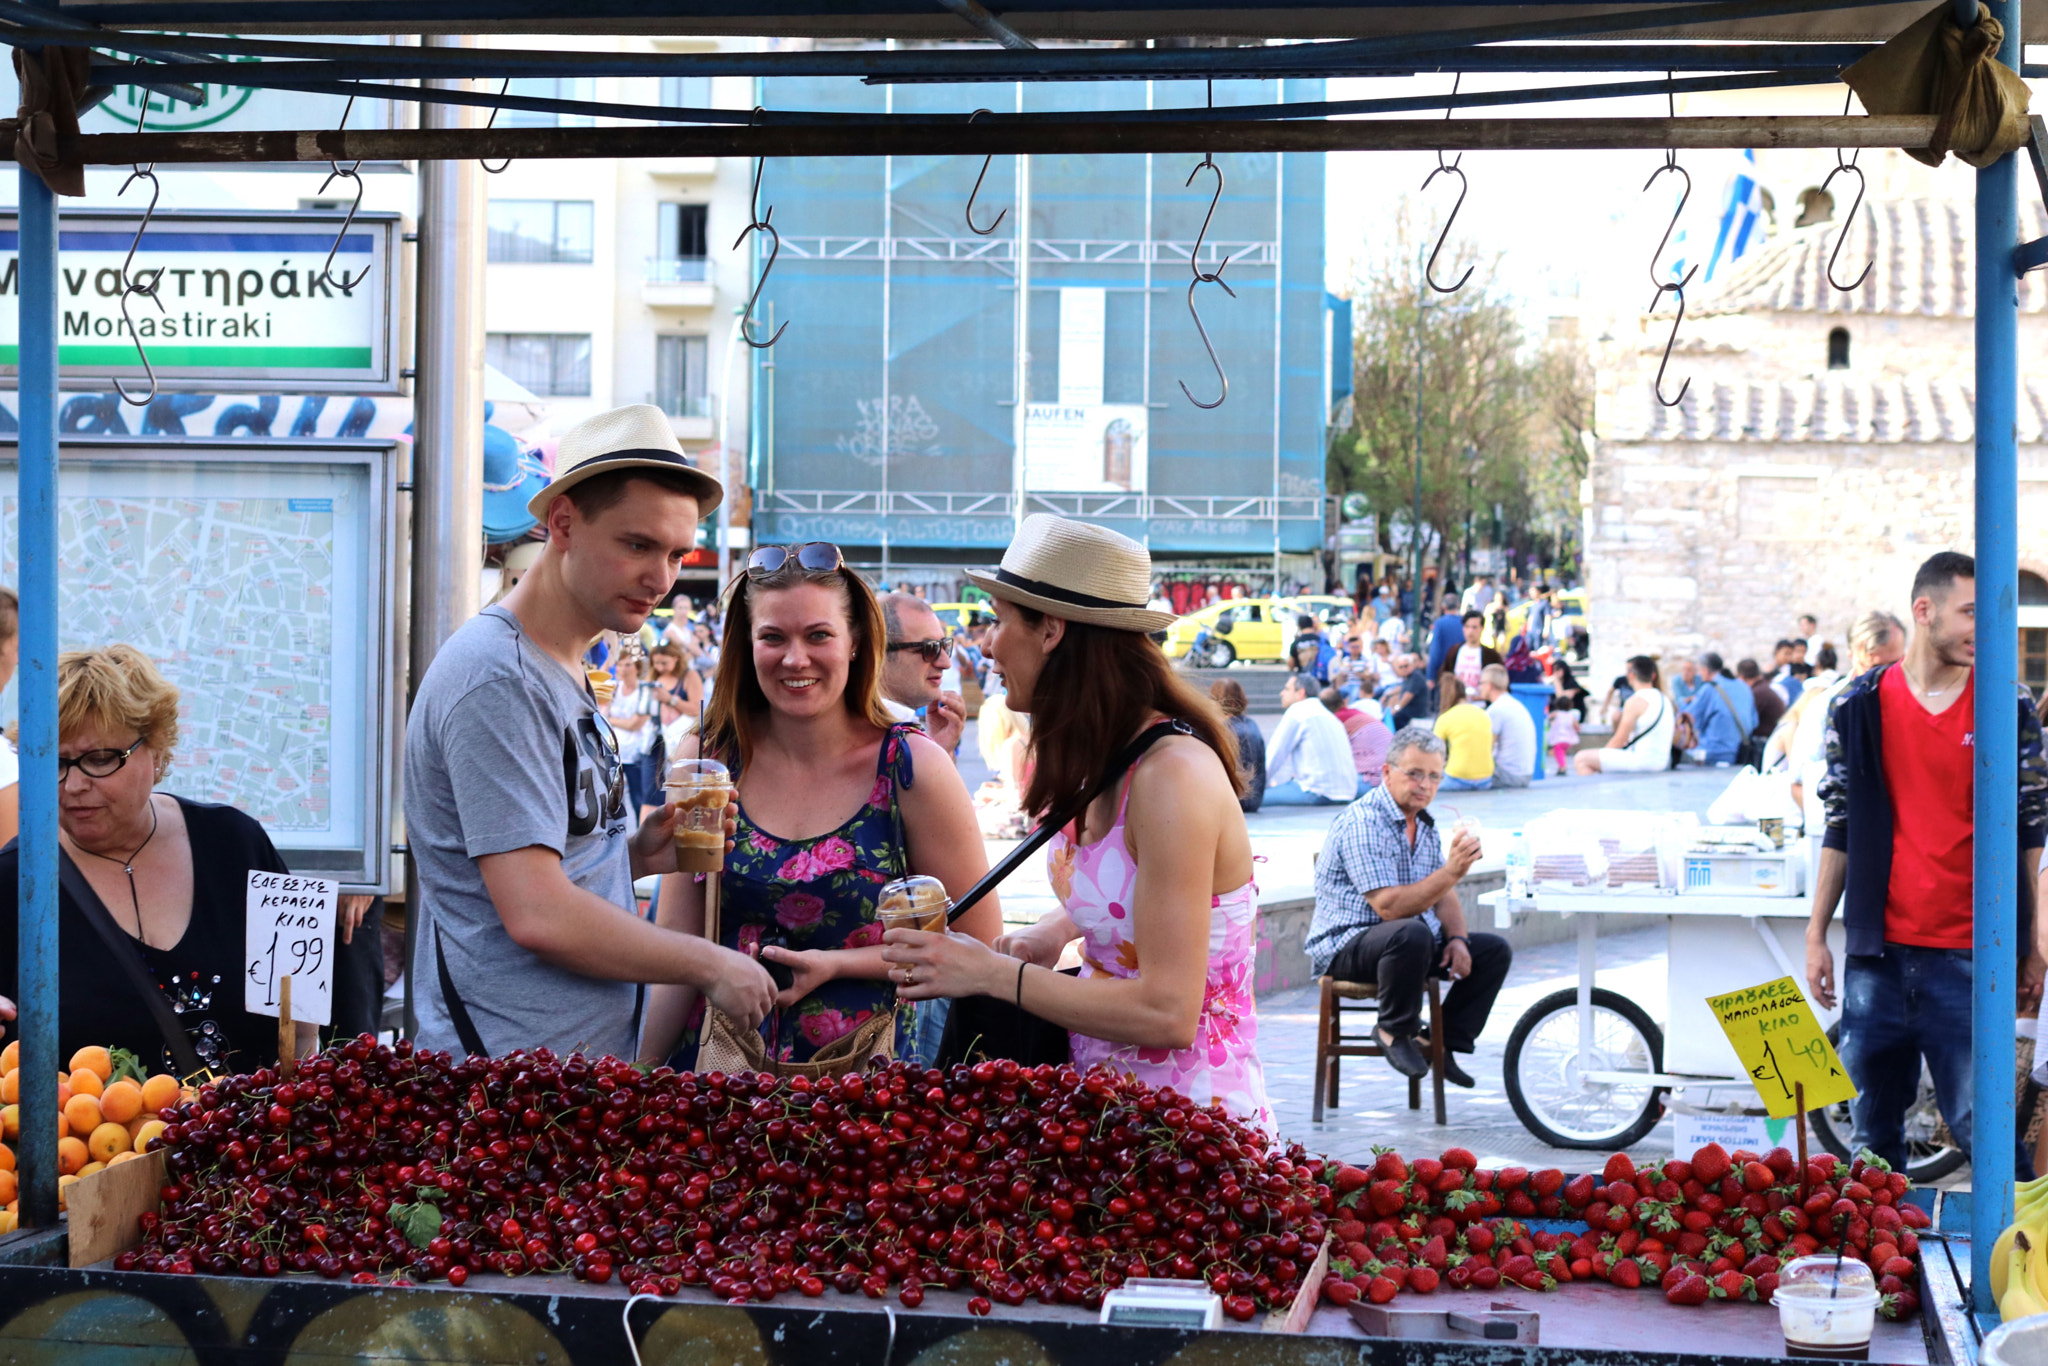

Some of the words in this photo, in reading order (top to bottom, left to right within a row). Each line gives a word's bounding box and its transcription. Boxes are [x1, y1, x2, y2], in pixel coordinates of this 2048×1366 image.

[0, 257, 354, 306] Μναστηράκι
[64, 311, 272, 338] Monastiraki
[275, 911, 319, 930] ΚΙΛΟ
[1758, 1013, 1800, 1036] ΚΙΛΟ
